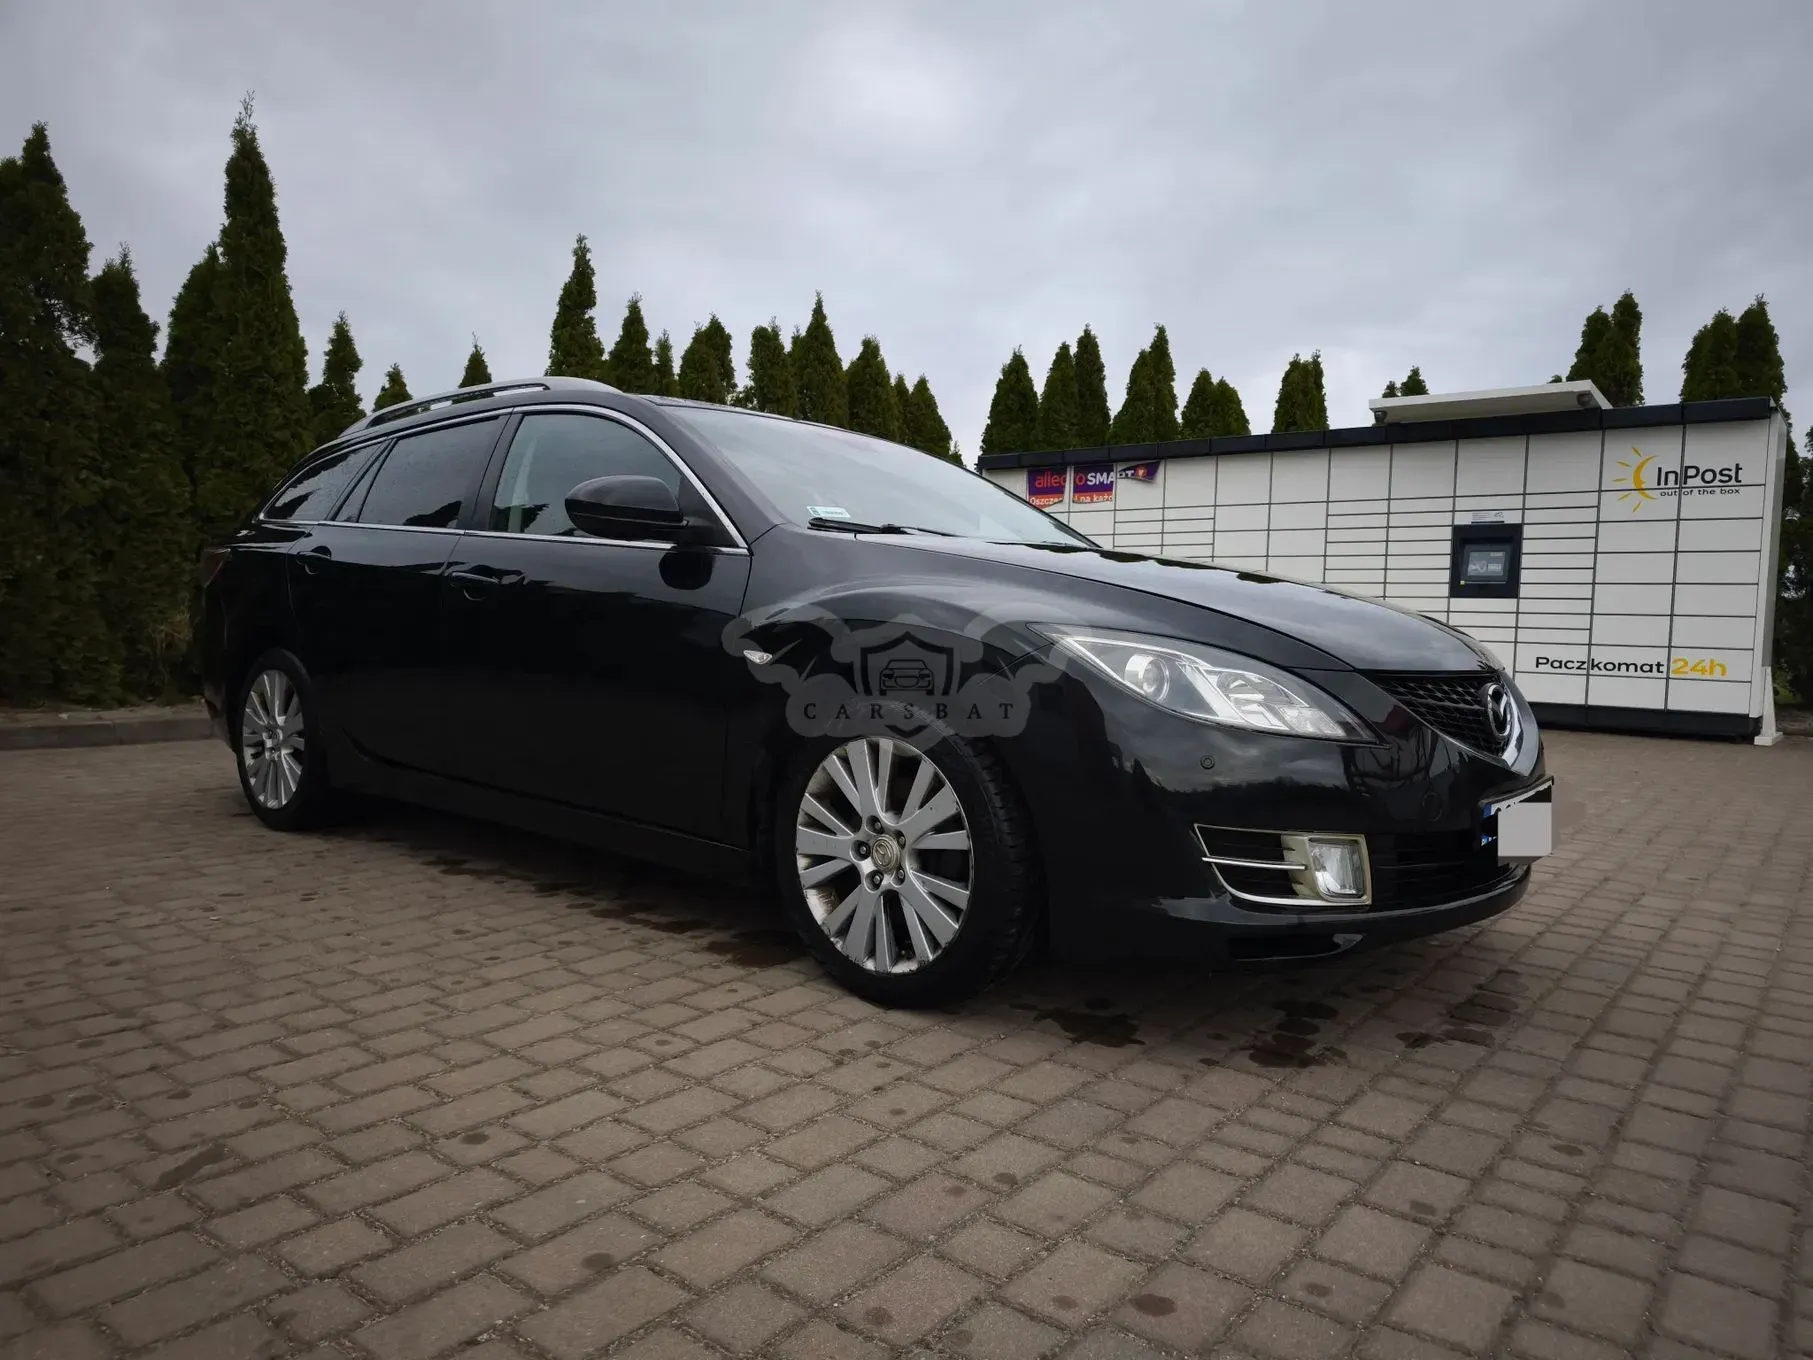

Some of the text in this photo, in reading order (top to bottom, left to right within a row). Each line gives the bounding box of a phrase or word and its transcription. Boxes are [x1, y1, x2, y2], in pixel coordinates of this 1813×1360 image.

[1657, 463, 1743, 486] InPost
[1535, 656, 1727, 676] Paczkomat 24h
